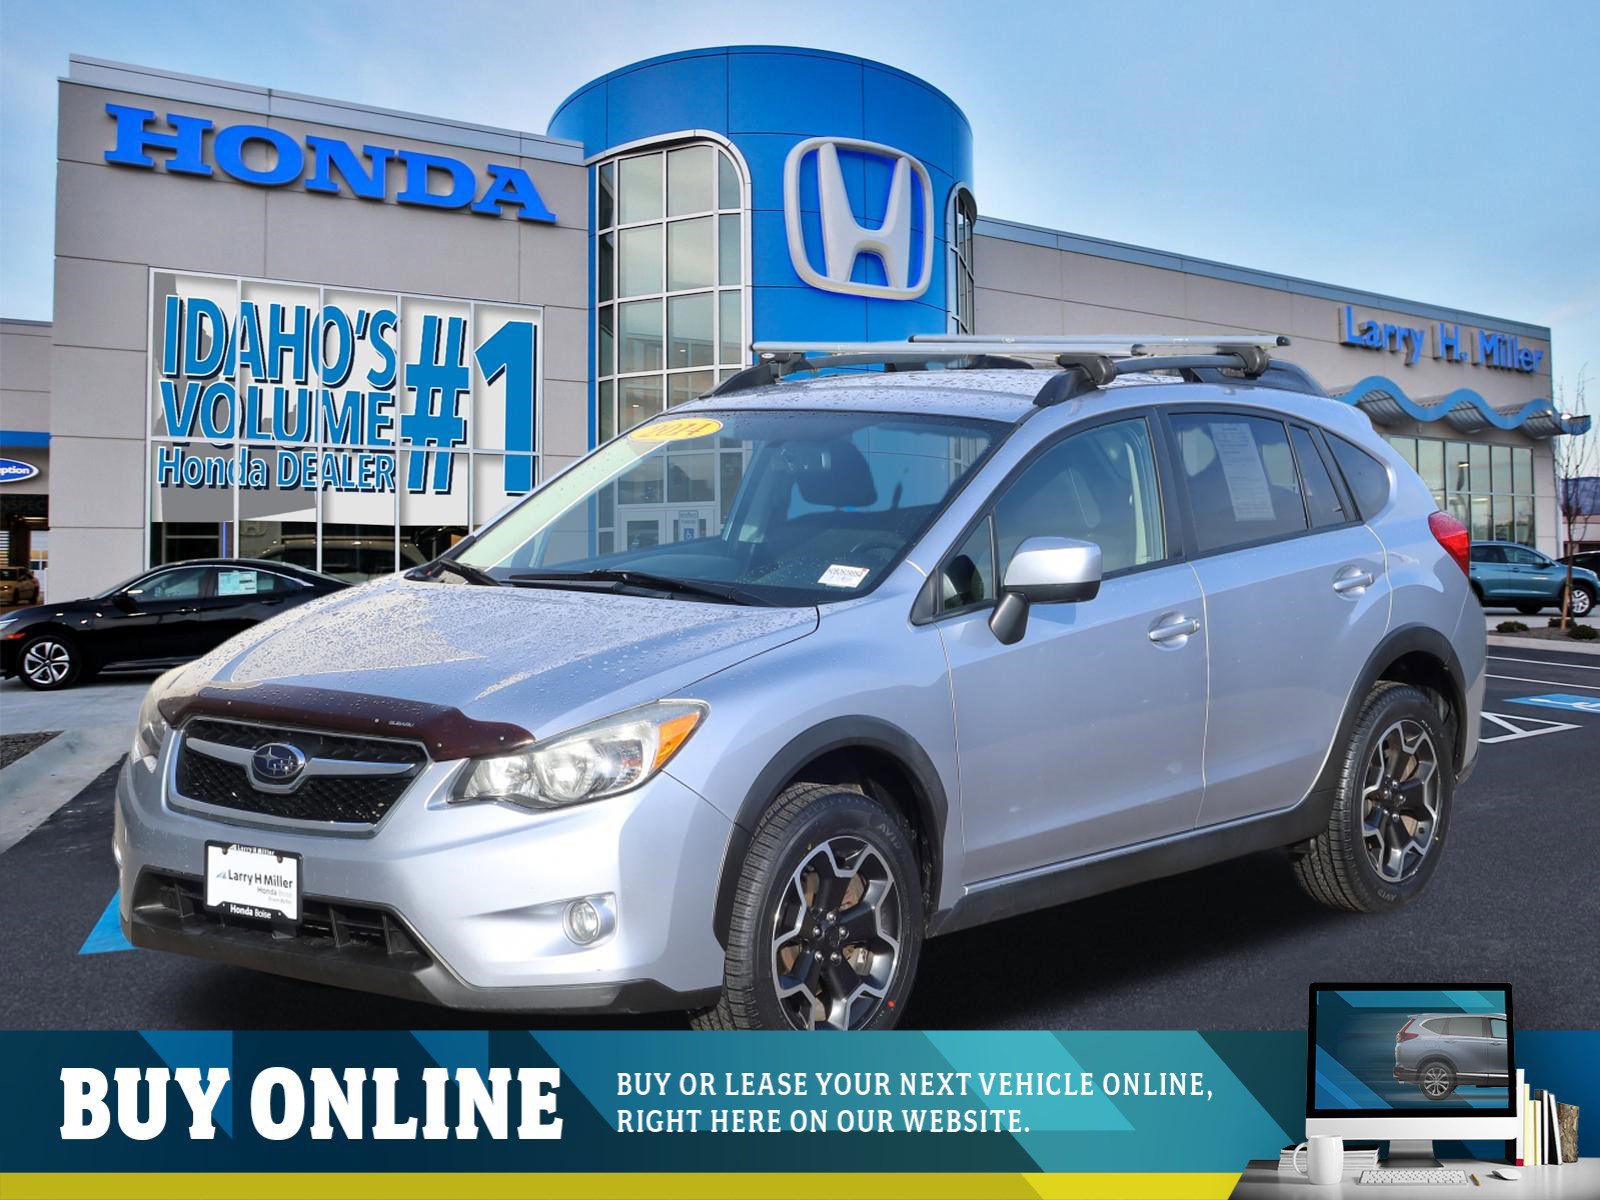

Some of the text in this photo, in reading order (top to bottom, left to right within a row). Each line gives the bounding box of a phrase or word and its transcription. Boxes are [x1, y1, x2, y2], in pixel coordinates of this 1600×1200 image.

[105, 103, 557, 224] HONDA
[1338, 305, 1545, 373] Larry H. Miller
[159, 379, 398, 448] VOLUME
[162, 294, 541, 497] IDAHO'S #1
[156, 446, 397, 493] Honda DEALER
[227, 869, 294, 889] Larry H Miller
[257, 886, 277, 896] Honda
[229, 904, 272, 919] Honda Boise
